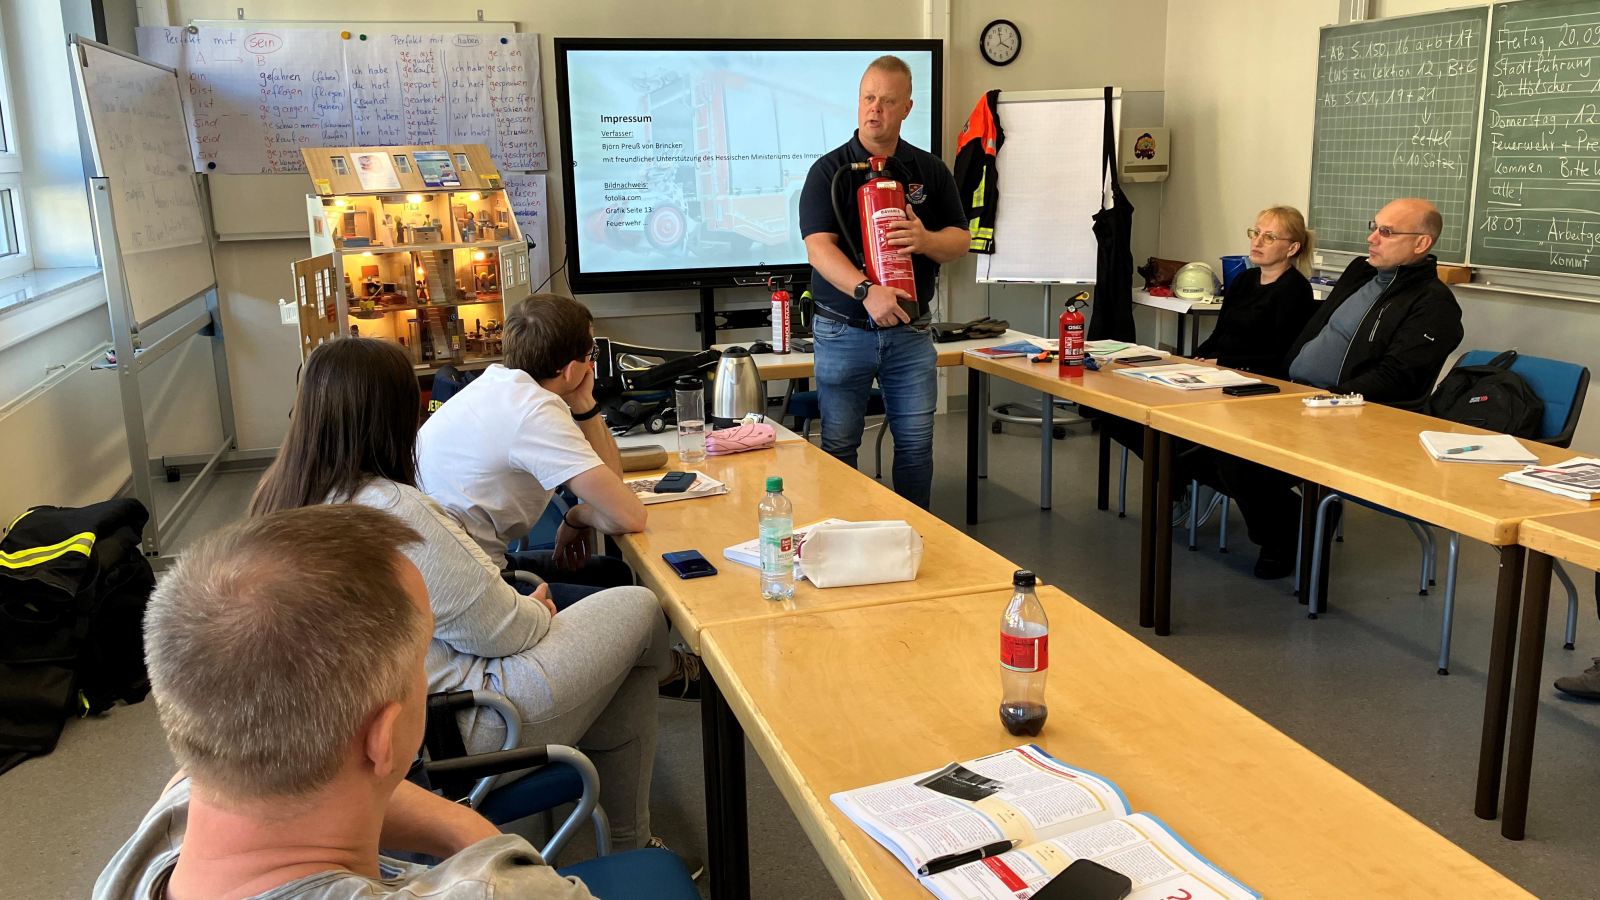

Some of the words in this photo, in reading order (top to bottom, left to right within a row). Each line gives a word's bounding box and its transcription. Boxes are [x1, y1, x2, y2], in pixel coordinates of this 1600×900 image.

[164, 28, 201, 46] Perfekt
[213, 32, 236, 45] mit
[250, 37, 275, 49] sein
[391, 35, 422, 47] Perfekt
[430, 35, 443, 43] mit
[457, 35, 480, 44] haben
[1330, 45, 1345, 61] AB
[1350, 41, 1362, 60] S.
[1395, 35, 1409, 54] 16
[196, 52, 206, 64] A
[256, 55, 266, 66] B
[1493, 51, 1591, 78] Stadtführung
[189, 71, 207, 81] bin
[351, 65, 363, 75] ich
[368, 64, 388, 75] habe
[403, 64, 436, 78] gekauft
[452, 61, 464, 72] ich
[467, 61, 485, 72] habe
[487, 62, 523, 78] gesehen
[1353, 68, 1366, 80] zu
[1372, 63, 1411, 80] Lektion
[259, 68, 301, 87] gefahren
[452, 79, 464, 88] du
[467, 77, 485, 88] hast
[489, 79, 528, 92] gesprochen
[189, 83, 214, 94] bist
[352, 80, 364, 89] du
[371, 79, 390, 89] hast
[403, 78, 438, 94] gespart
[1496, 80, 1513, 98] Dr.
[1518, 73, 1573, 97] Hölscher
[260, 86, 303, 102] geflogen
[373, 92, 388, 105] hat
[404, 93, 446, 107] gearbeitet
[466, 92, 479, 103] hat
[1324, 92, 1337, 107] AB
[1386, 88, 1404, 104] 19
[199, 98, 214, 108] ist
[354, 113, 371, 122] wir
[377, 108, 400, 121] haben
[407, 117, 438, 130] geputzt
[405, 106, 439, 120] getanzt
[453, 112, 468, 120] wir
[471, 108, 495, 119] haben
[497, 116, 531, 128] gegessen
[600, 114, 652, 124] Impressum
[195, 132, 221, 144] seid
[357, 125, 370, 136] ihr
[377, 125, 400, 136] habt
[407, 127, 438, 140] gemacht
[454, 128, 467, 137] ihr
[470, 124, 492, 137] habt
[1411, 125, 1452, 148] Zettel
[264, 131, 310, 148] gelaufen
[500, 140, 538, 152] gesungen
[602, 143, 619, 151] Björn
[1491, 131, 1556, 152] Feuerwehr
[656, 155, 701, 163] Unterstützung
[1559, 156, 1590, 178] Bitte
[507, 187, 537, 198] elesen
